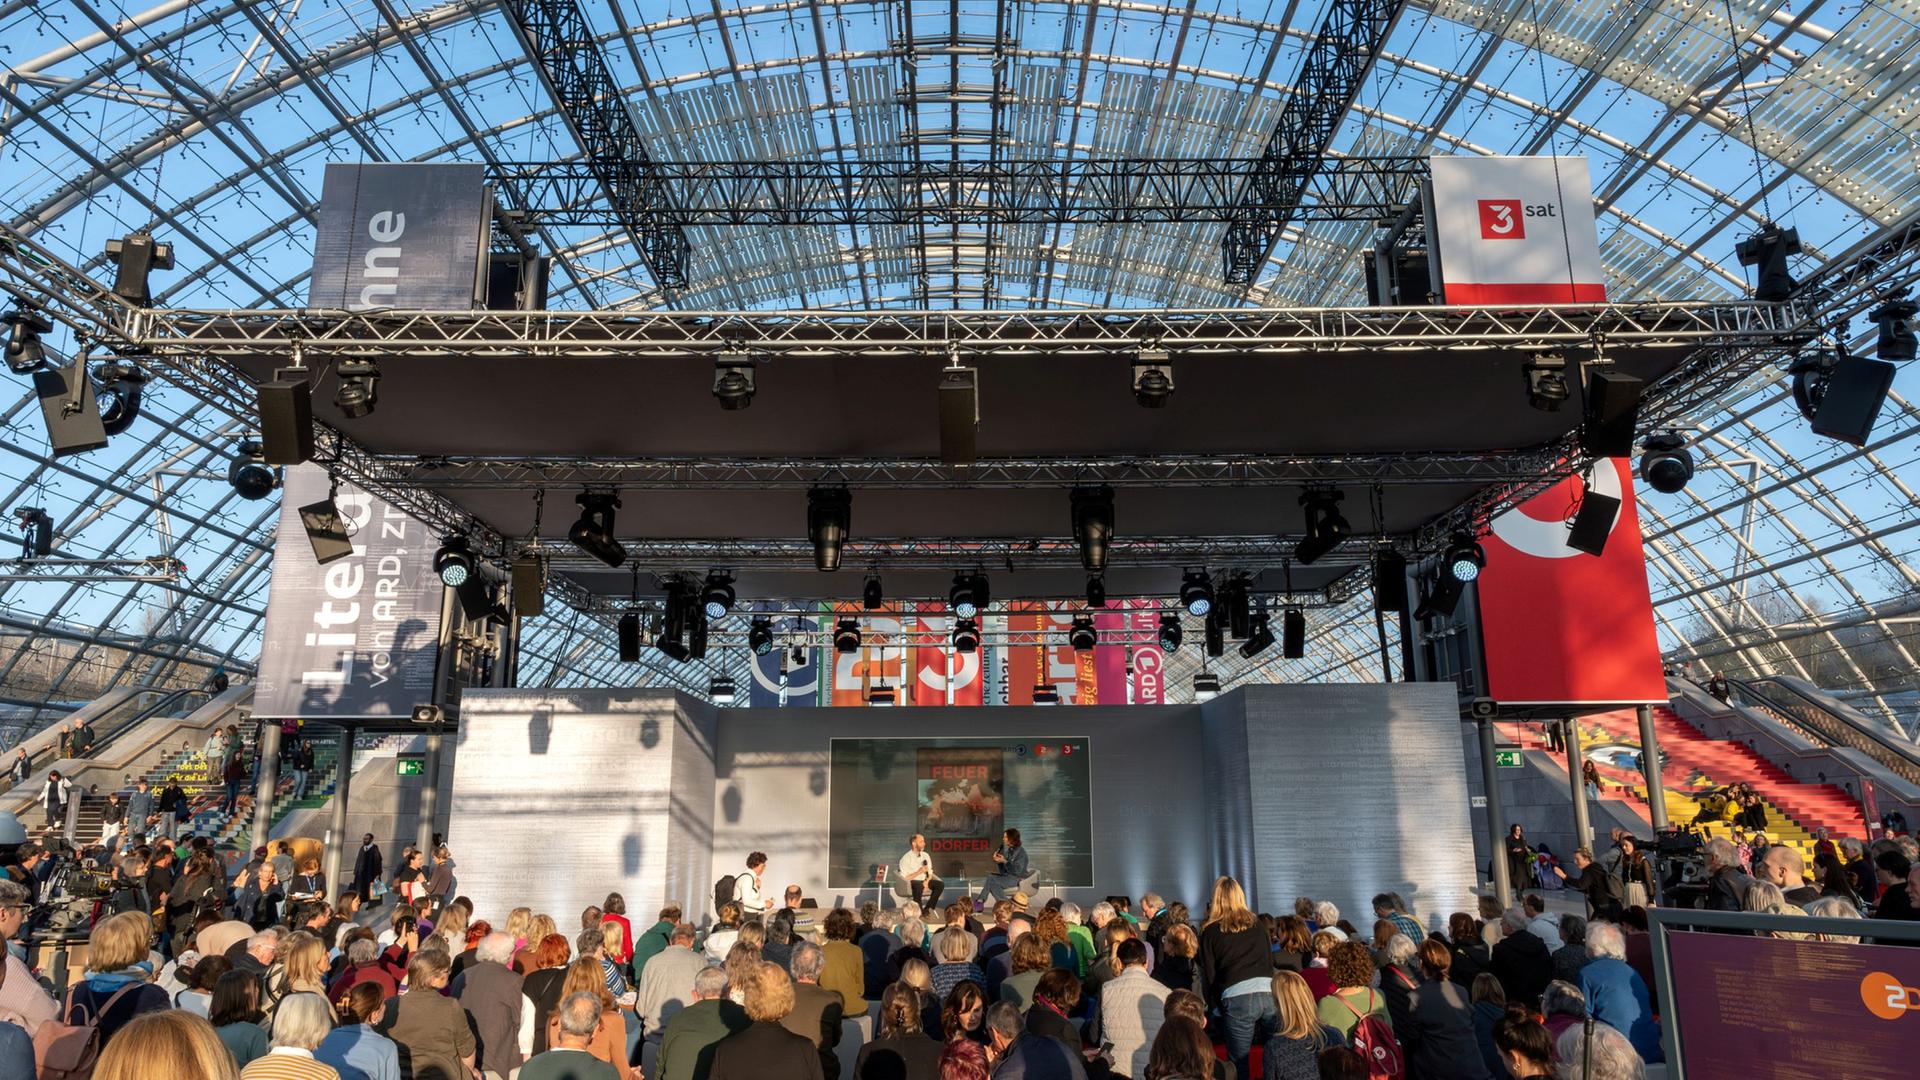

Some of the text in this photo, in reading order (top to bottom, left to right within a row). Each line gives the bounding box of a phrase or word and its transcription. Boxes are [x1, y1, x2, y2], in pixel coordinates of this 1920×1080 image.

[370, 632, 392, 688] von
[1080, 654, 1094, 682] liest
[931, 765, 989, 779] FEUER
[931, 836, 991, 853] DÖRFER
